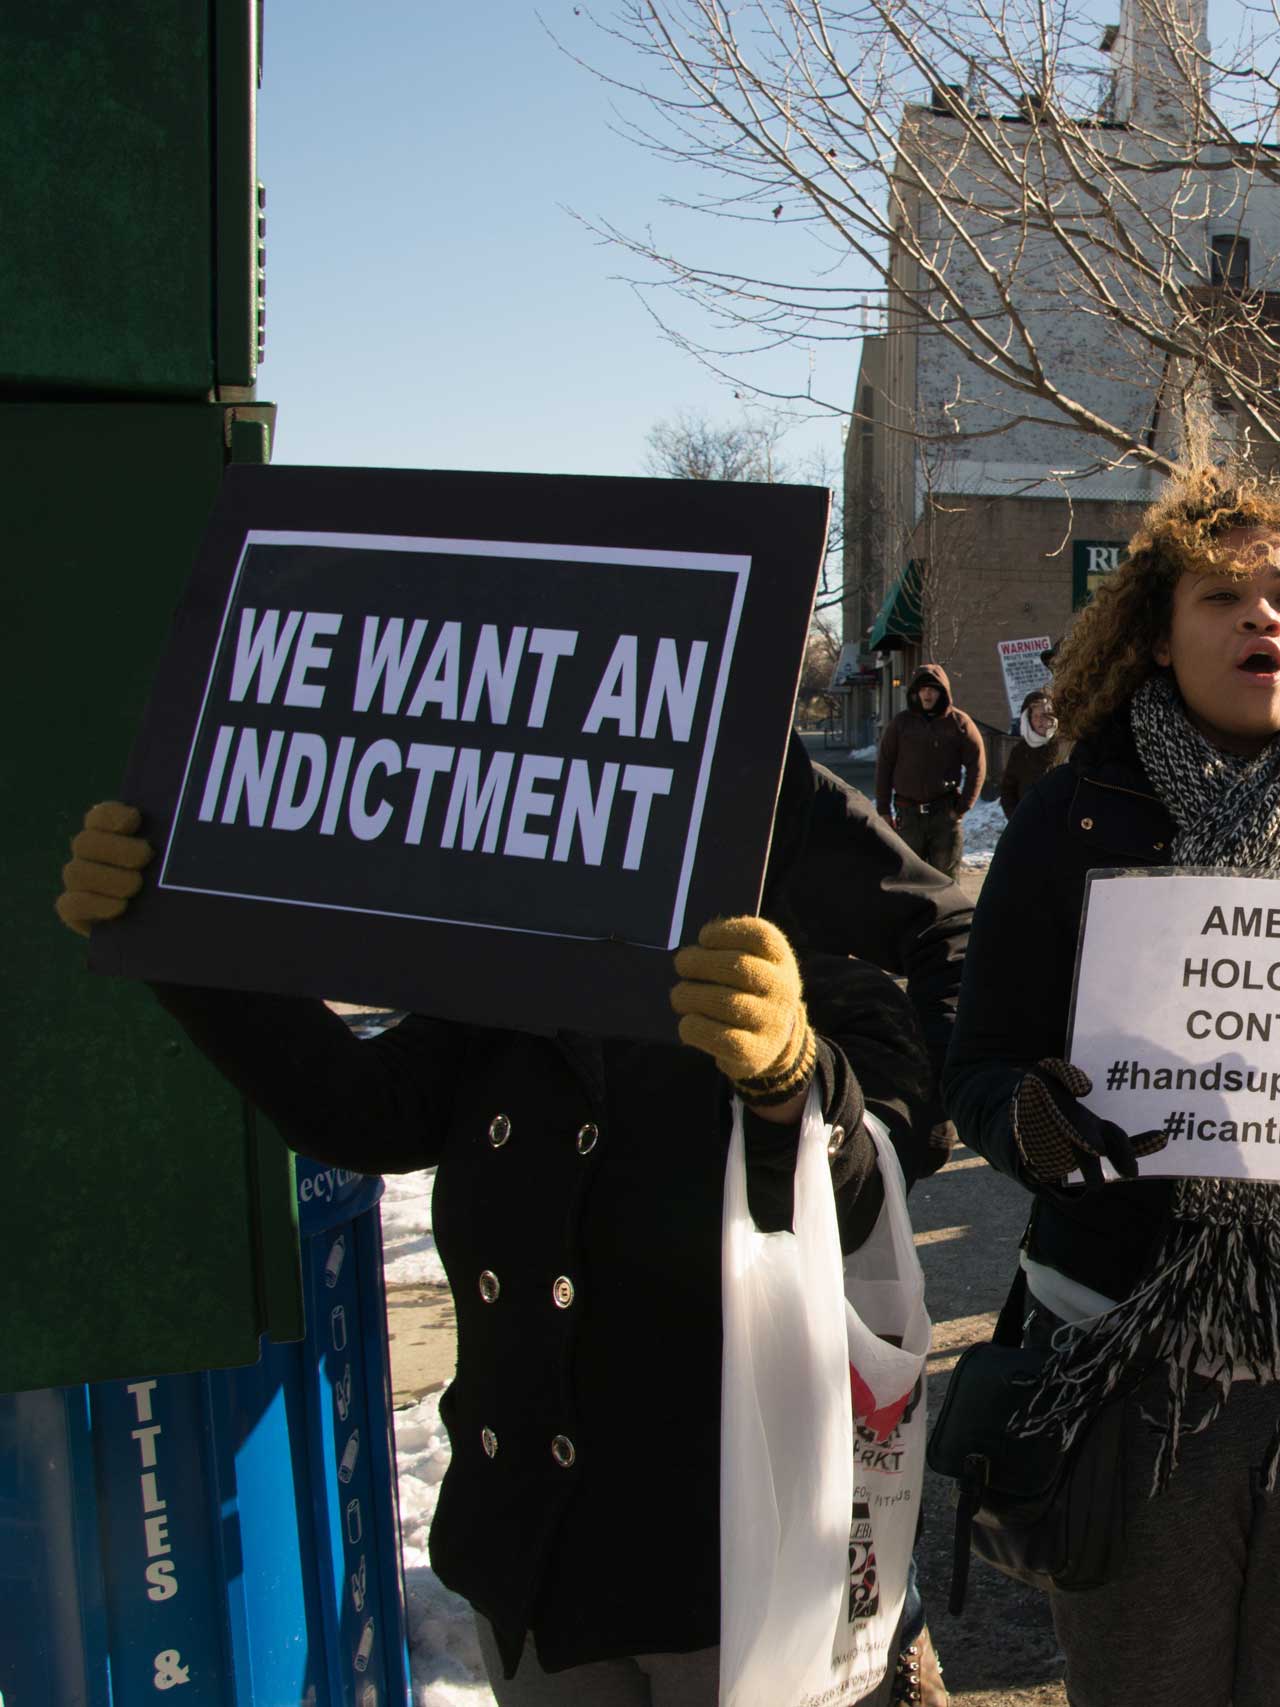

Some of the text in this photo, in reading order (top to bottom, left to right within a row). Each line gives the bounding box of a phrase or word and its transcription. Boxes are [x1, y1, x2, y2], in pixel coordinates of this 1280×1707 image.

[229, 607, 709, 742] WE WANT AN
[1000, 639, 1049, 655] WARNING
[198, 725, 674, 870] INDICTMENT
[127, 1379, 191, 1690] TTLES &
